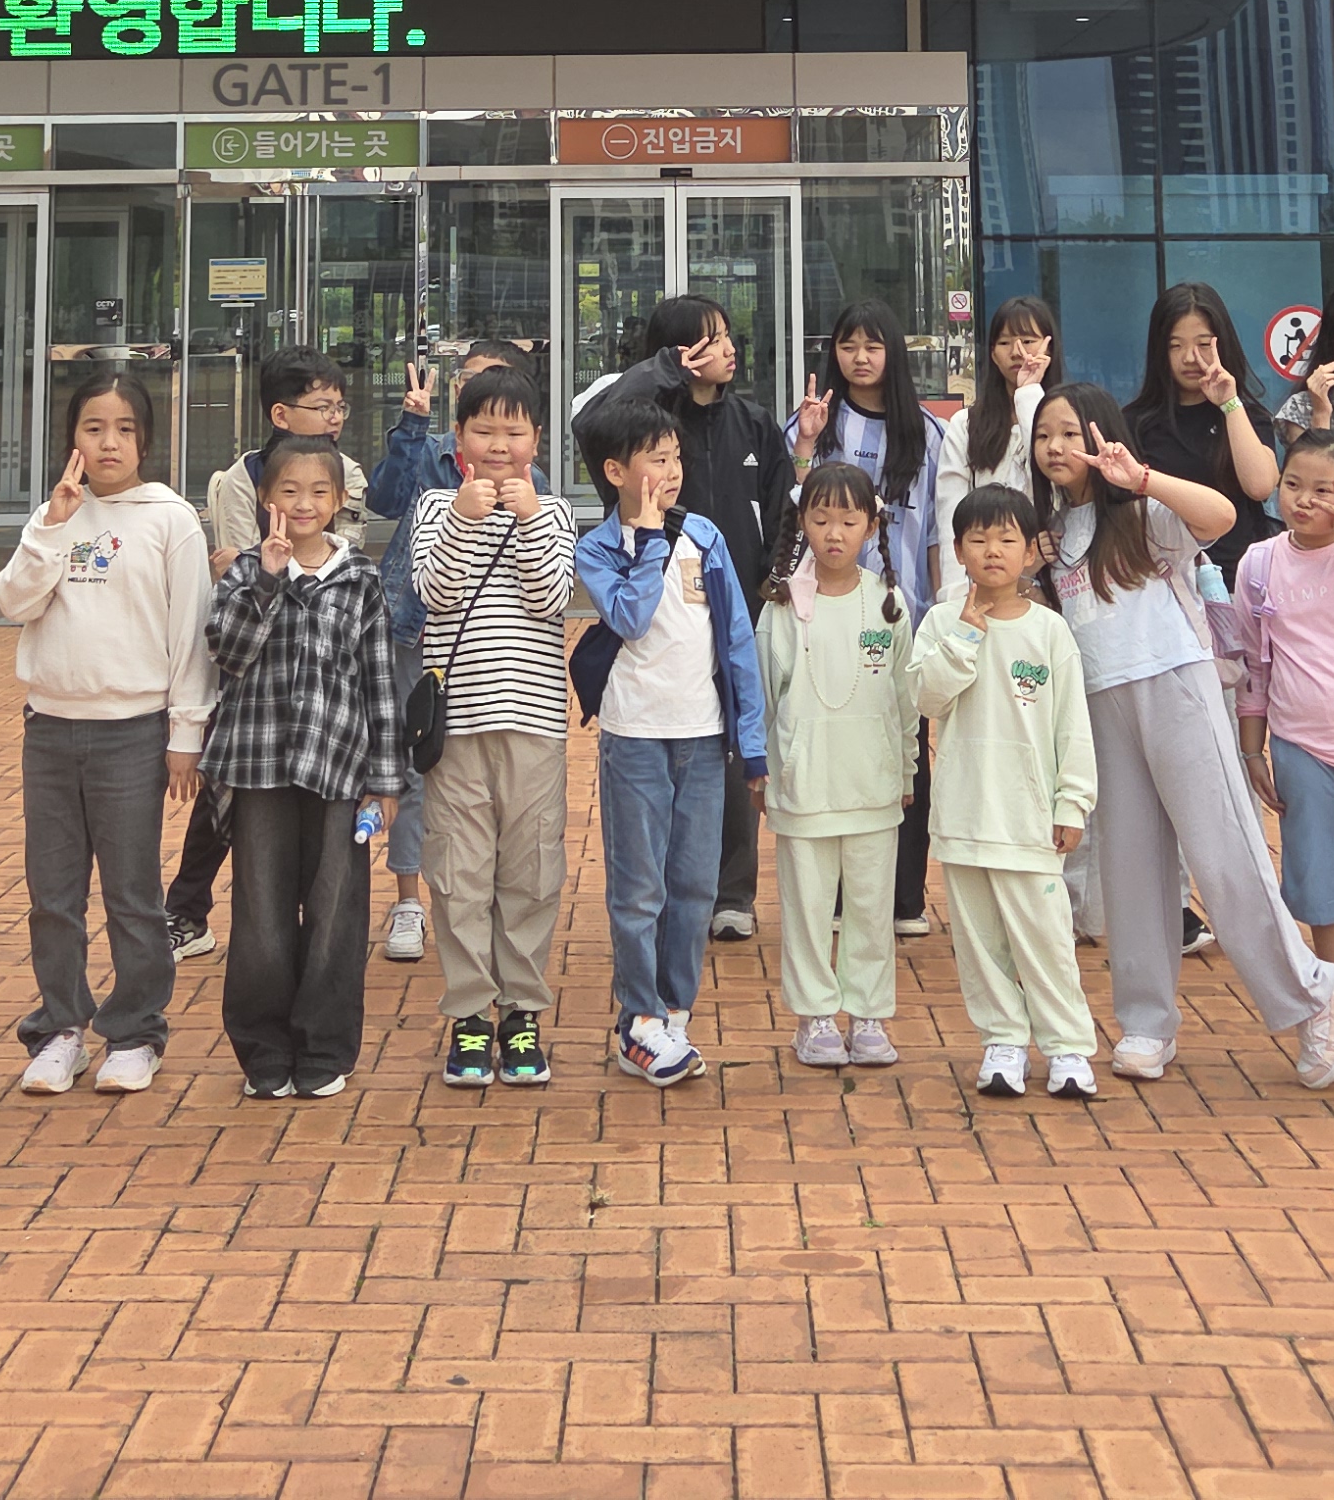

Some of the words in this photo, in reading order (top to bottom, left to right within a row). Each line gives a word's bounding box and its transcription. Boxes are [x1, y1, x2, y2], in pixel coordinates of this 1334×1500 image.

[212, 62, 391, 107] GATE-1
[252, 130, 356, 159] 들어가는
[363, 130, 389, 158] 곳
[641, 125, 742, 154] 진입금지
[96, 300, 116, 308] CCTV
